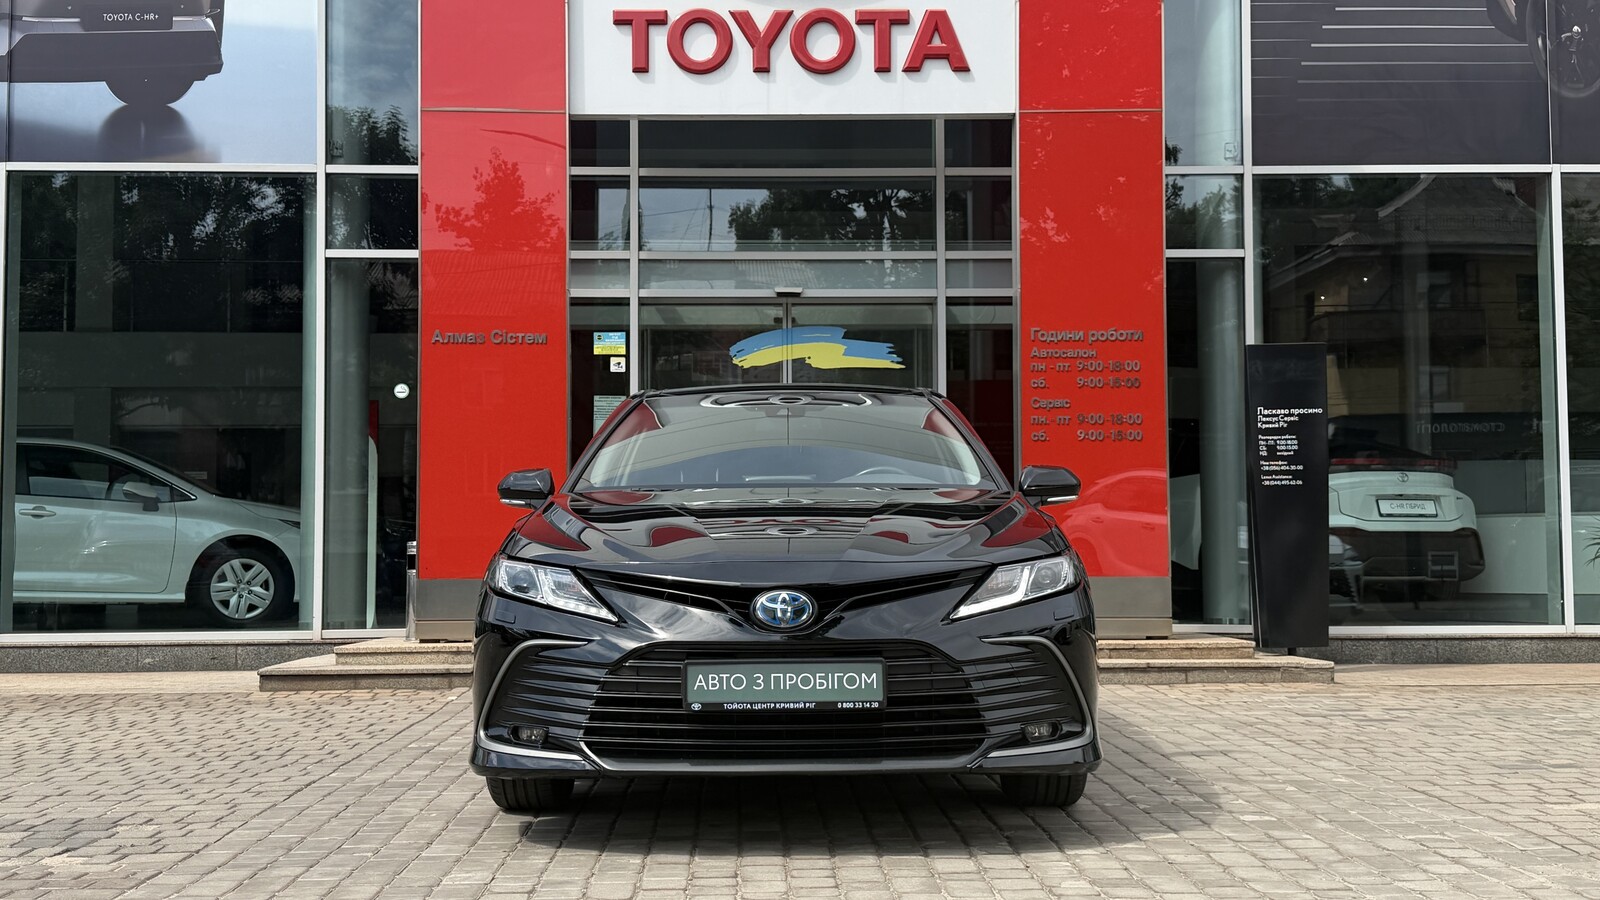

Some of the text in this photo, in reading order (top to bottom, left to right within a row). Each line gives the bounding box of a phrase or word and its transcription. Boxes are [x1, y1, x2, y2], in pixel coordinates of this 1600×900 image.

[102, 13, 159, 21] TOYOTA C-HR+
[613, 8, 971, 74] TOYOTA
[431, 329, 548, 344] Алмаз Сістем
[1030, 327, 1144, 344] Години роботи
[1030, 346, 1097, 358] Автосалон
[1030, 397, 1071, 410] Сервіс
[1257, 407, 1289, 415] Ласкаво
[1389, 502, 1405, 510] C-HR
[693, 672, 877, 690] АВТО З ПРОБІГОМ
[723, 702, 752, 710] ТОЙОТА
[752, 702, 775, 710] ЦЕНТР
